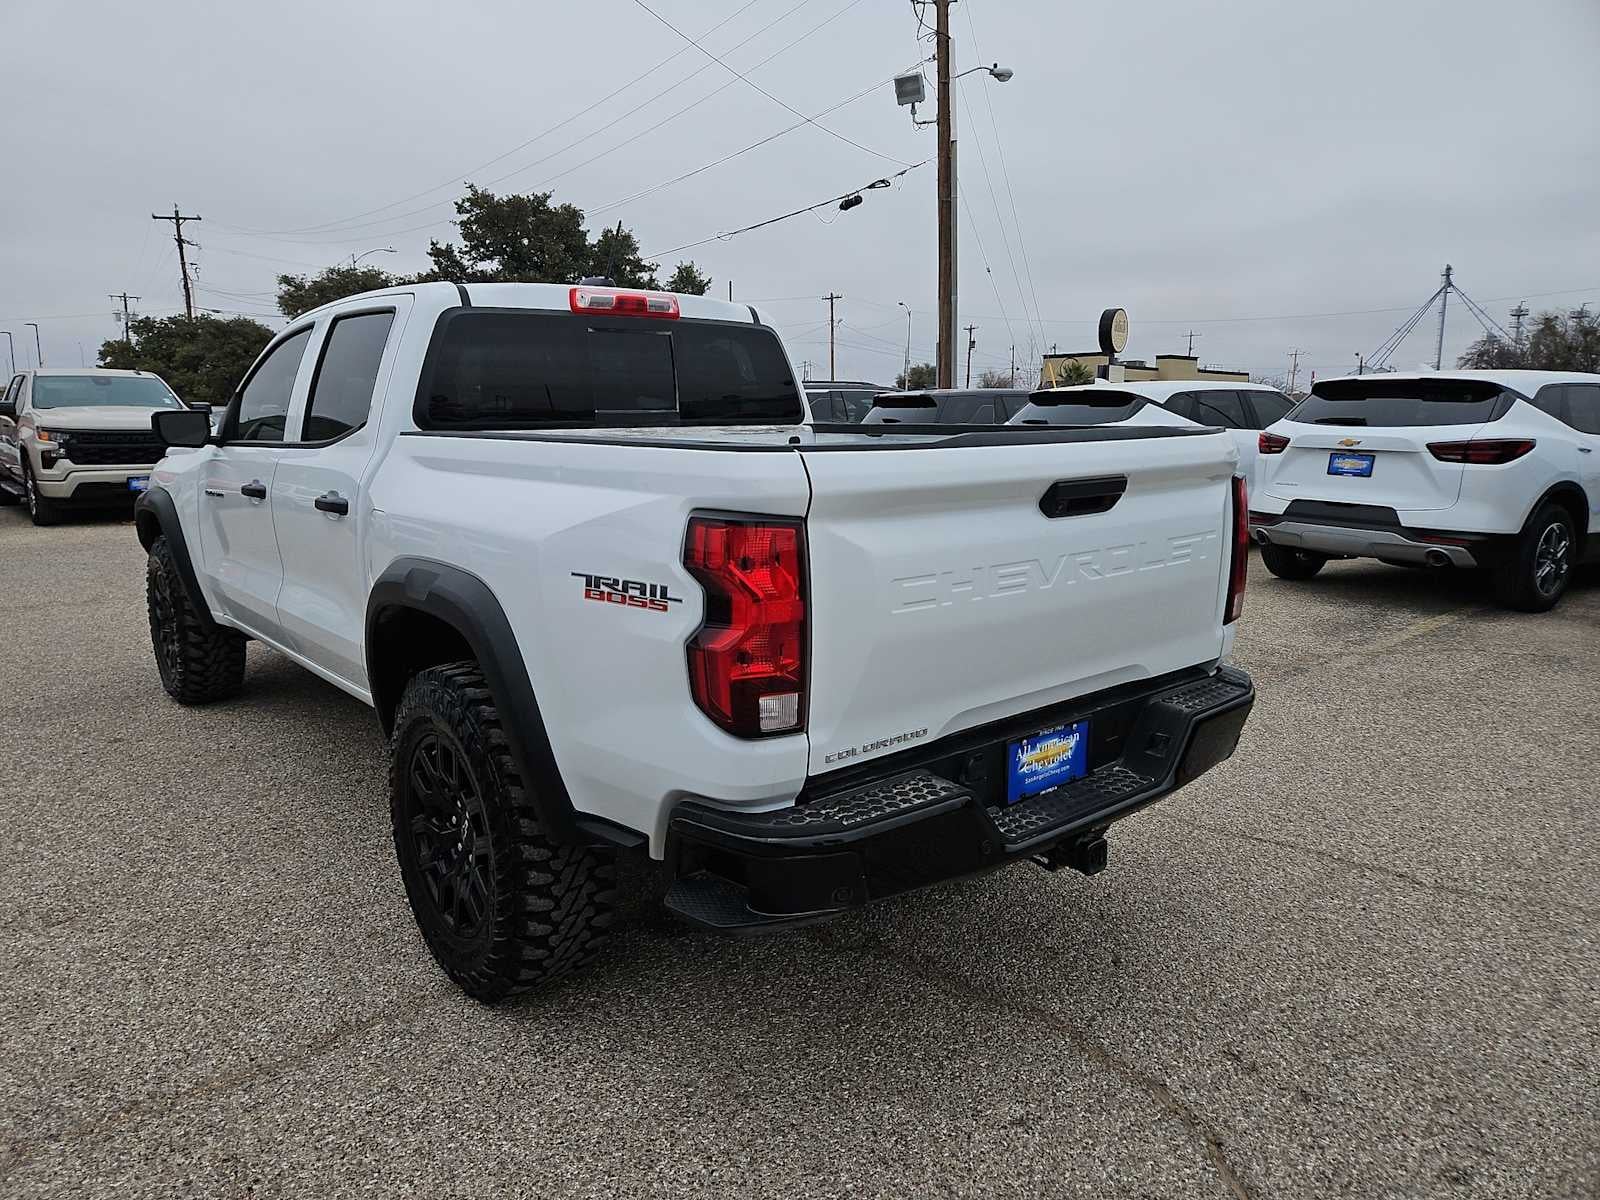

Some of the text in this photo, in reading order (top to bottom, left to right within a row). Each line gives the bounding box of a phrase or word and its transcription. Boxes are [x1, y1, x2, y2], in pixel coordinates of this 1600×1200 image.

[890, 529, 1218, 614] CHEVROLET
[570, 572, 683, 603] TRAIL
[584, 588, 669, 612] BOSS
[825, 728, 929, 763] COLORADO
[1016, 732, 1080, 761] All American
[1024, 749, 1073, 774] Chevrolet
